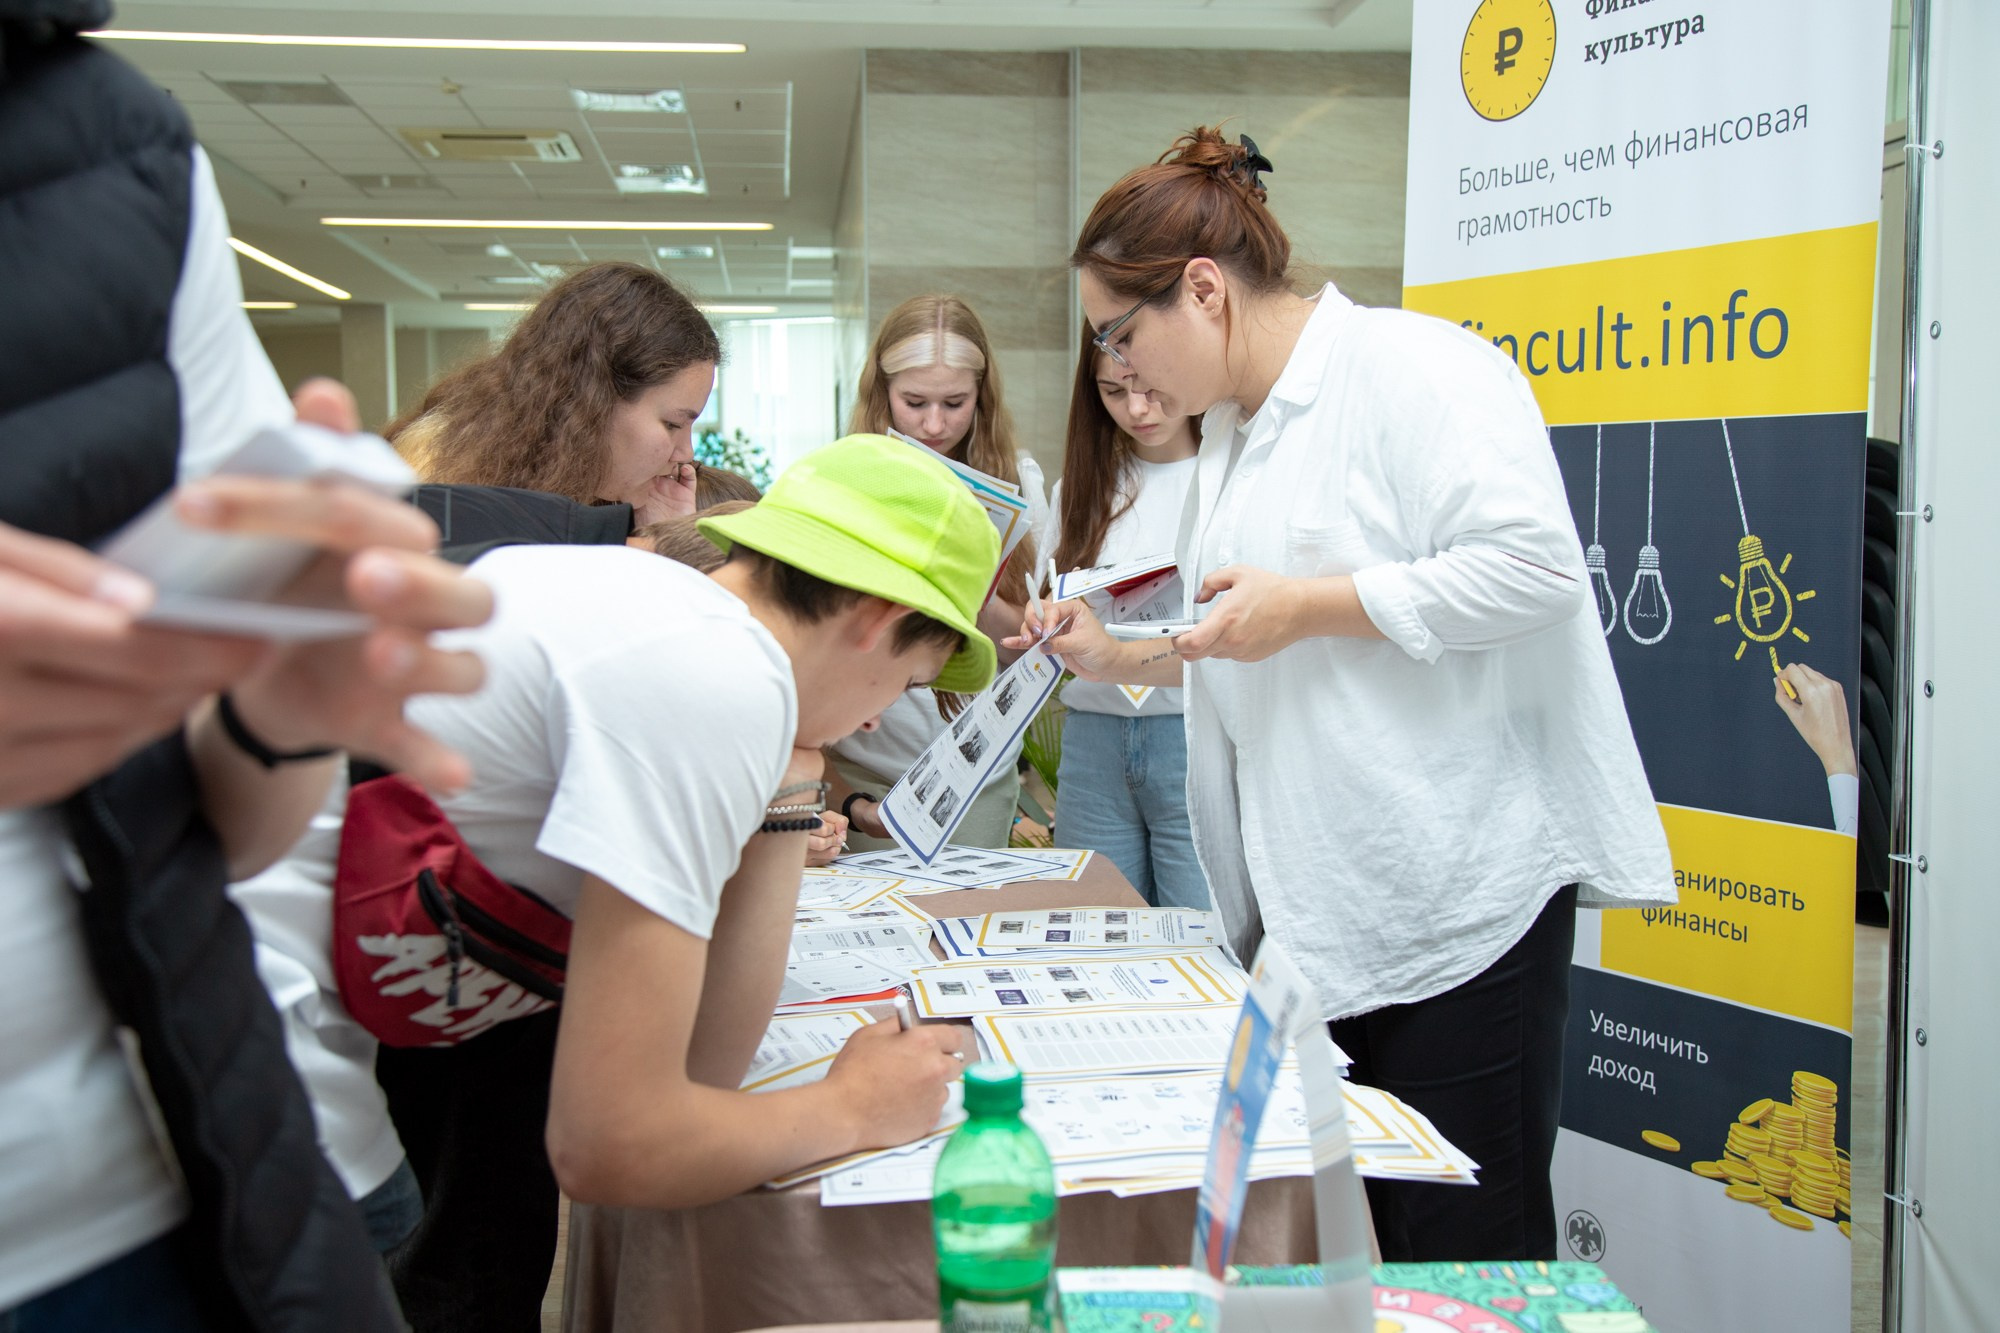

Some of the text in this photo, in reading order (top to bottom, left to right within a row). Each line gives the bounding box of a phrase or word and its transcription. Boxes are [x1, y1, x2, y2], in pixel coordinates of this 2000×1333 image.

[1584, 13, 1705, 65] культура
[1459, 103, 1808, 195] Больше, чем финансовая
[1458, 196, 1612, 246] грамотность
[1460, 289, 1790, 376] ncult.info
[1152, 652, 1168, 662] here
[1674, 869, 1805, 911] анировать
[1641, 907, 1748, 943] финансы
[1589, 1009, 1709, 1064] Увеличить
[1588, 1054, 1656, 1095] доход
